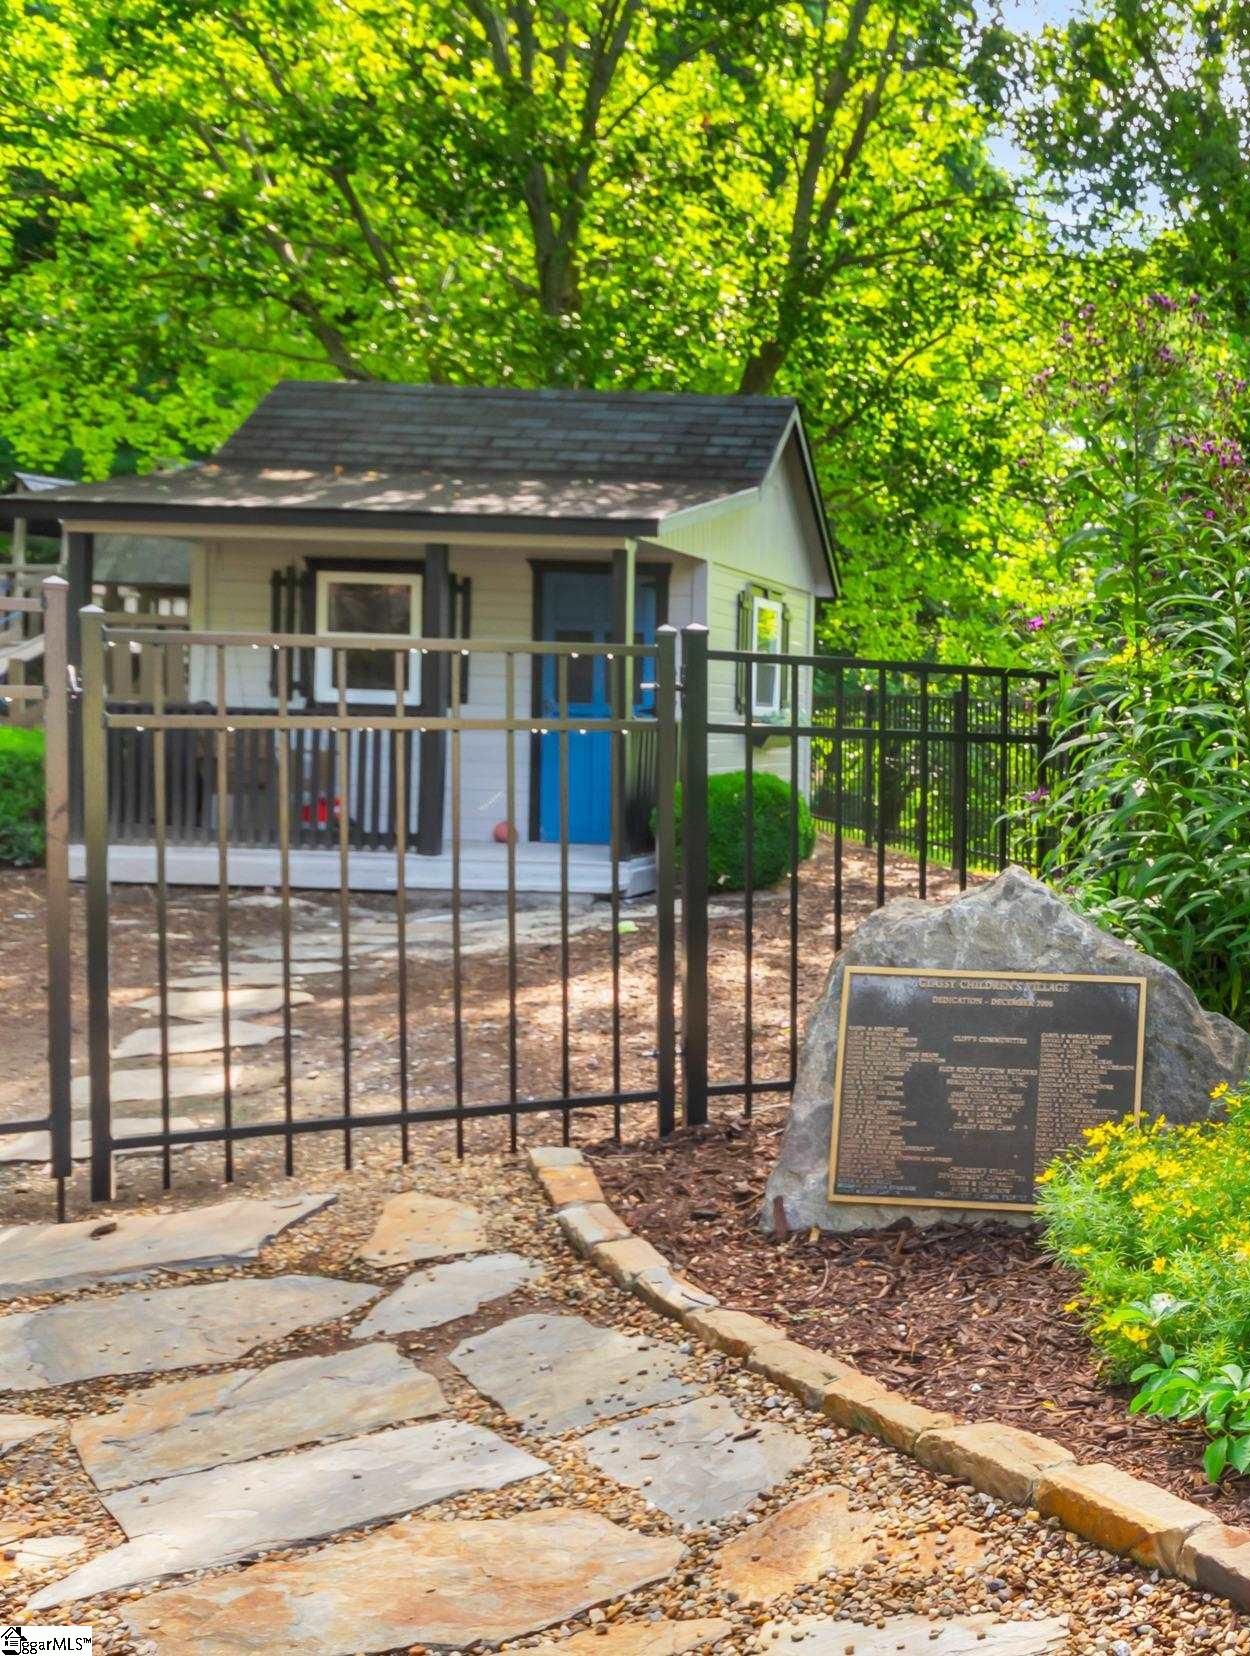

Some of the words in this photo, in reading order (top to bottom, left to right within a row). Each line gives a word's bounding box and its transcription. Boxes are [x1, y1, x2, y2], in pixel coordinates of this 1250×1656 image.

[1025, 982, 1069, 993] VILLAGE
[932, 996, 982, 1005] DEDICATION
[990, 998, 1034, 1007] DECEMBER
